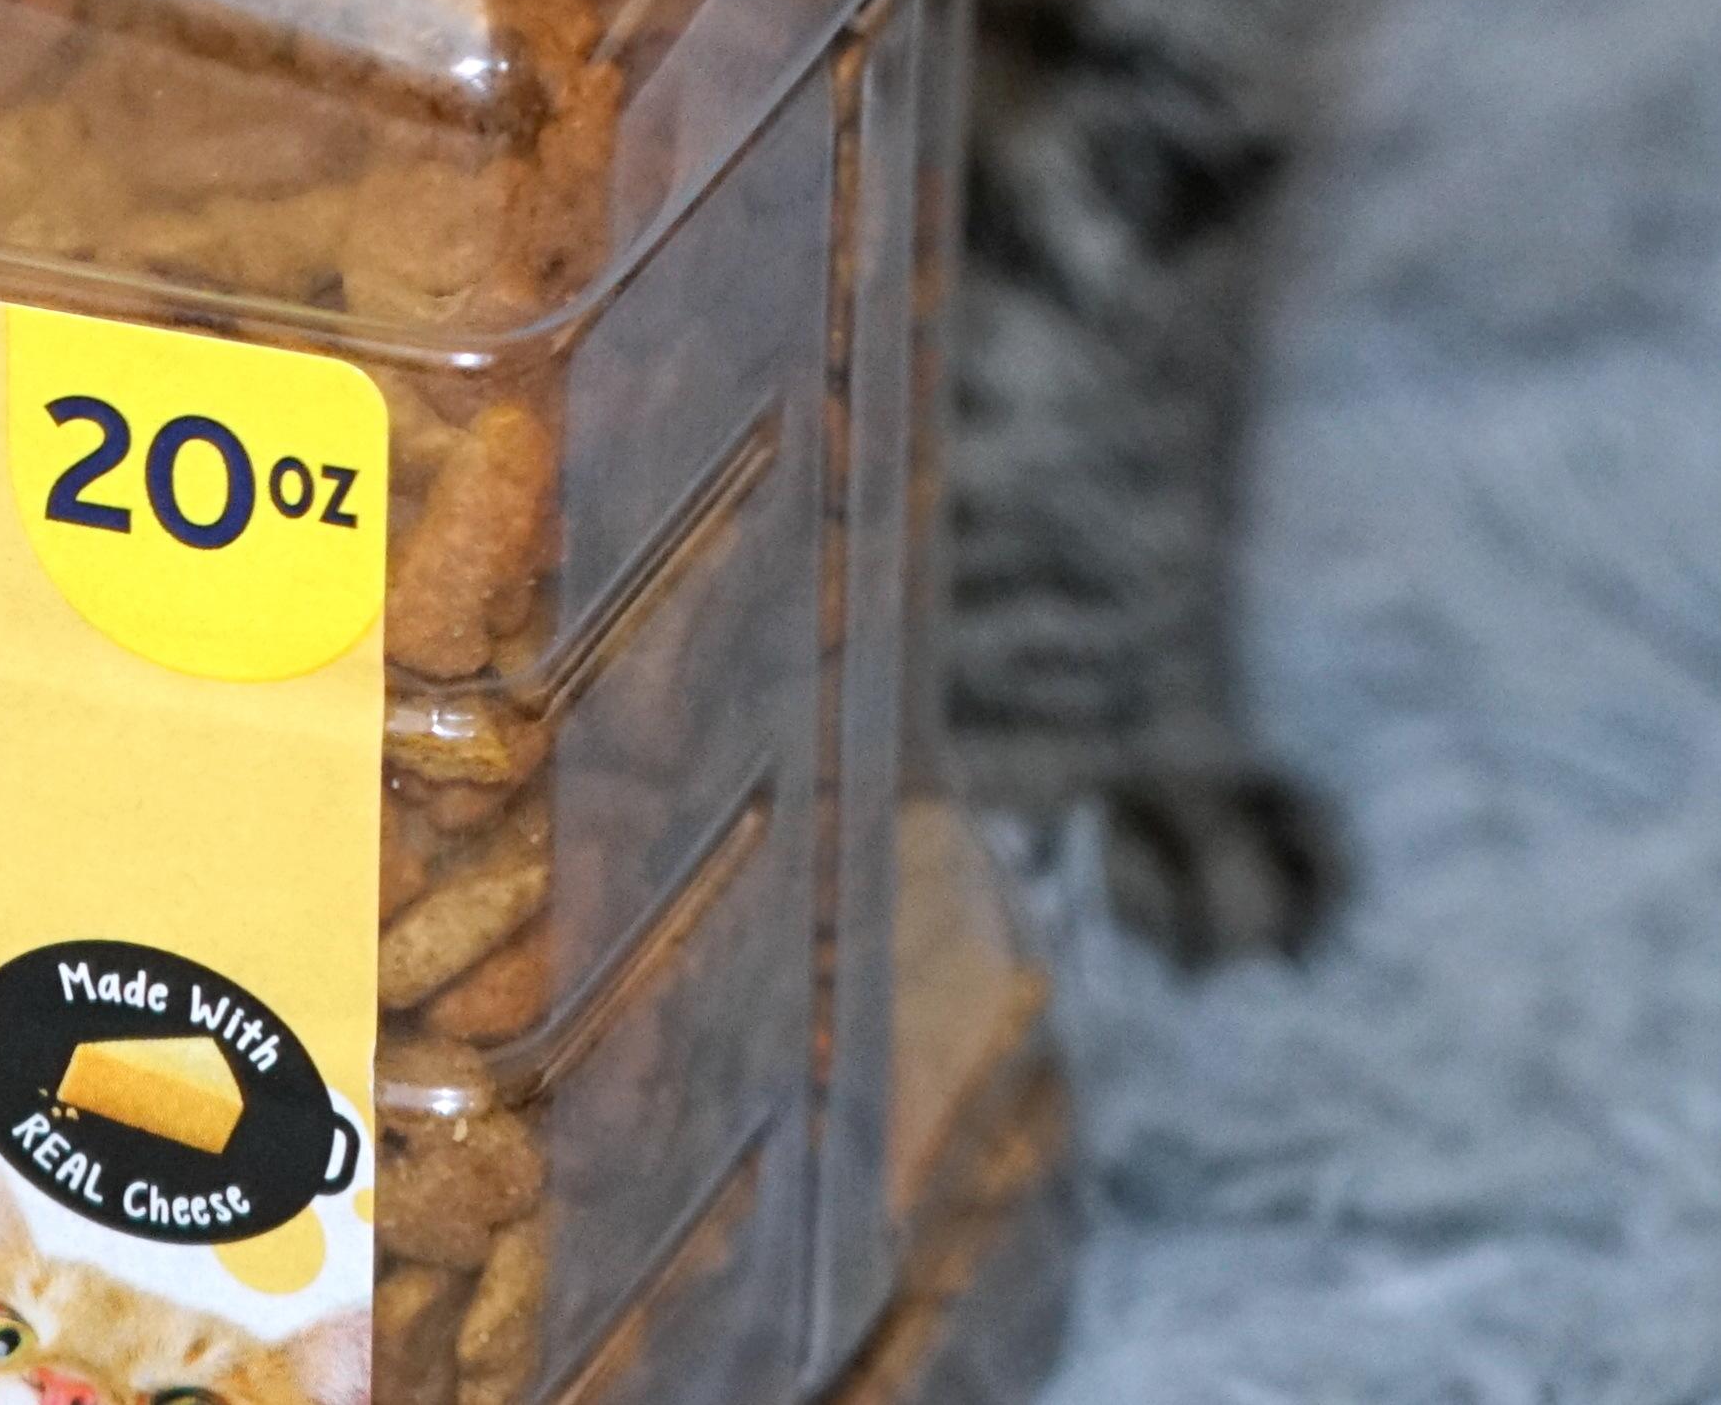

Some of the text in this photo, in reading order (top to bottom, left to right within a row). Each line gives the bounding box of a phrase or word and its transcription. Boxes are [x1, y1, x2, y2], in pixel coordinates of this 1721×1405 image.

[44, 394, 256, 550] 20
[57, 961, 279, 1073] Made With
[11, 1112, 252, 1227] REAL Cheese
